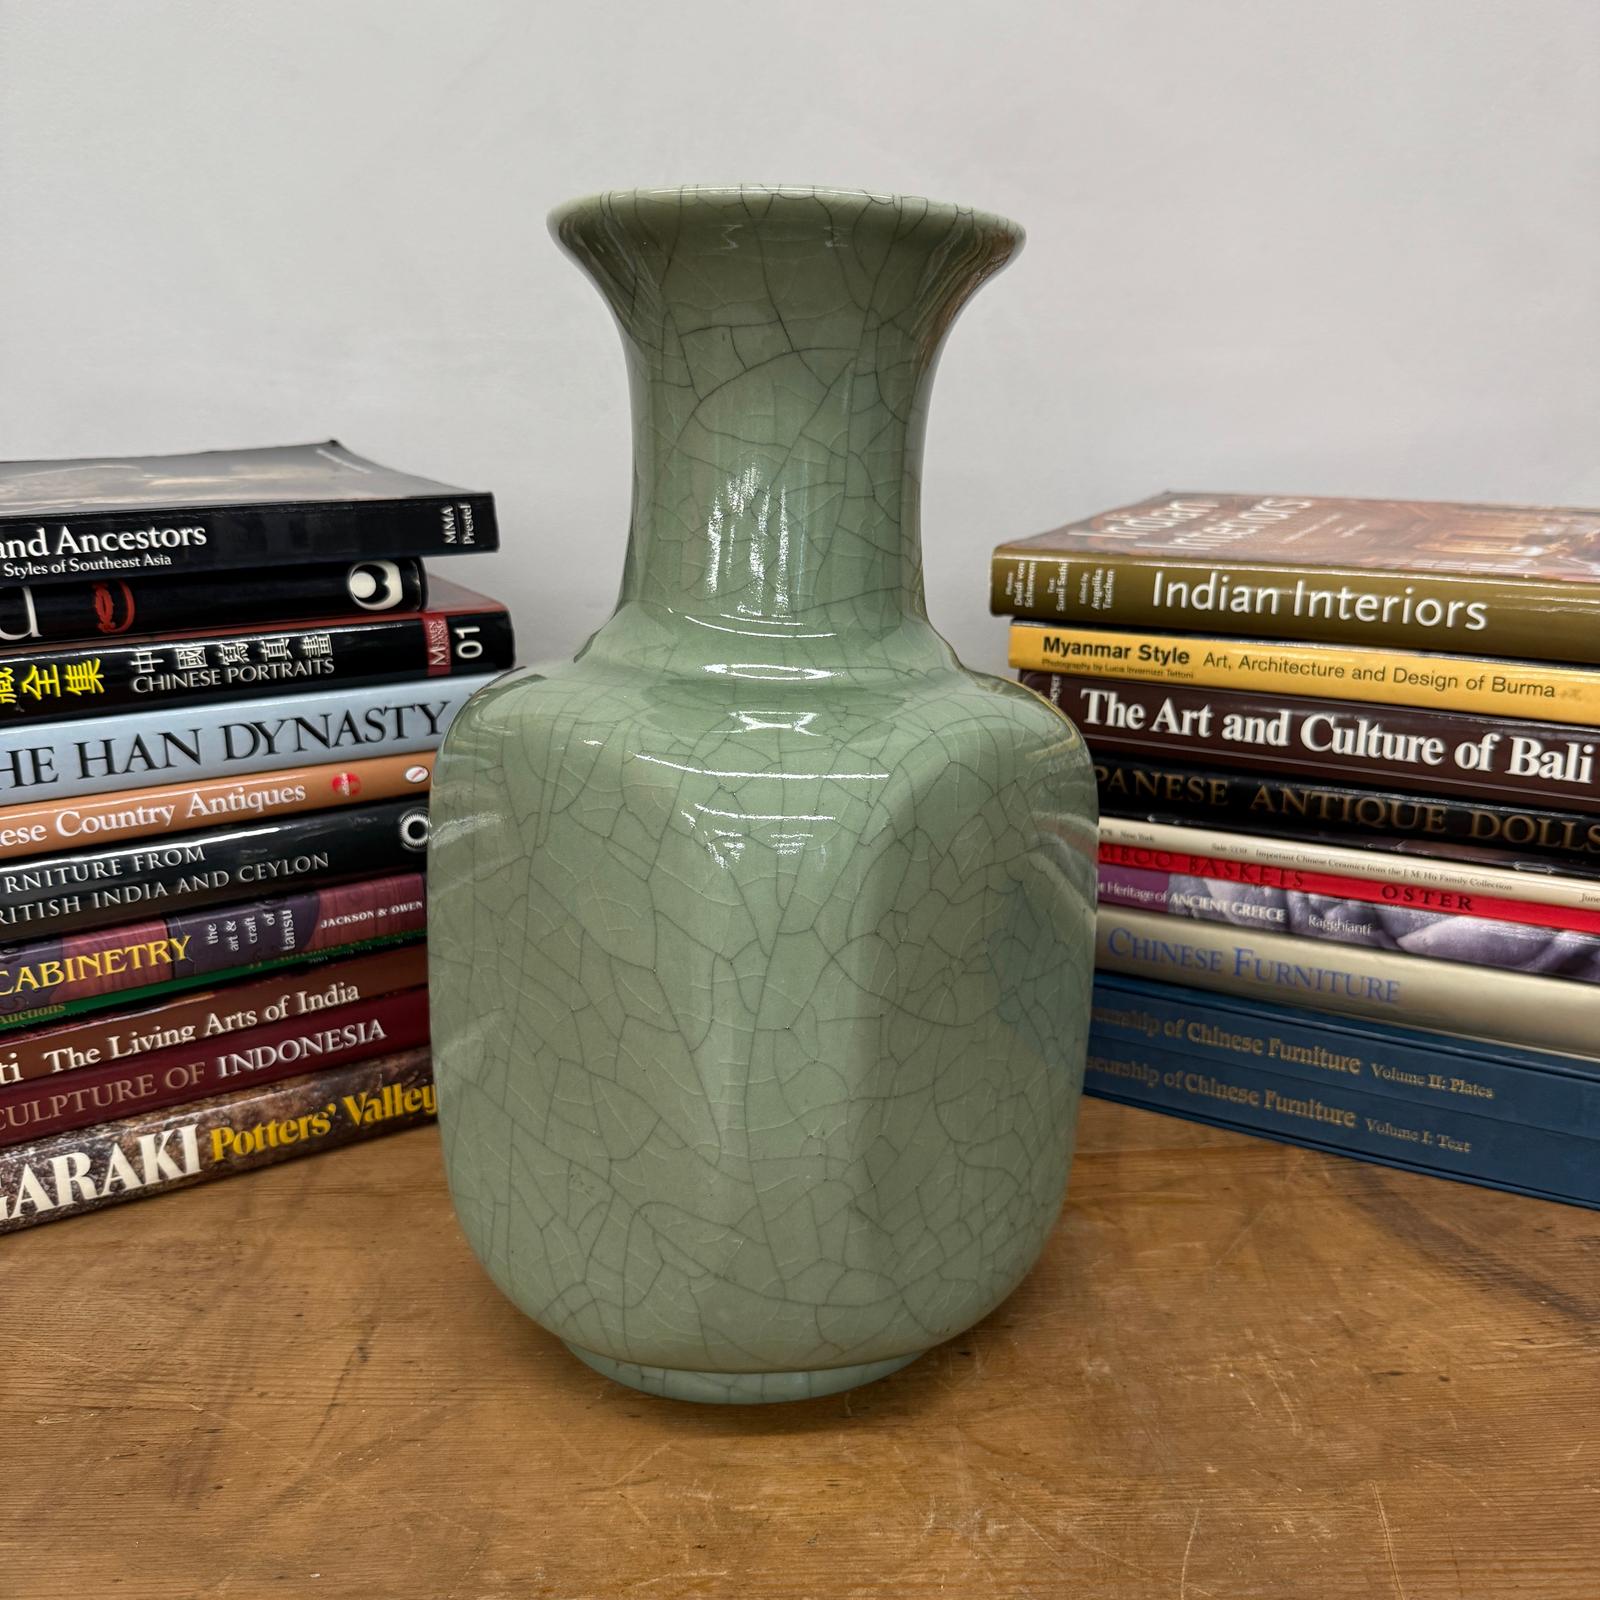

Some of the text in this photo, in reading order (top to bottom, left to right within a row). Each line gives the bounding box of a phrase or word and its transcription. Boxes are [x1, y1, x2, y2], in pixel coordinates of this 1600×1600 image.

[55, 525, 207, 555] Ancestors
[441, 505, 457, 544] MMA
[459, 503, 476, 544] Prestel
[4, 553, 172, 579] Styles of Southeast Asia
[1056, 588, 1065, 611] Sunil
[1091, 568, 1104, 610] Angelika
[1102, 569, 1115, 609] Taschen
[1152, 570, 1487, 631] Indian Interiors
[453, 626, 483, 659] 01
[132, 658, 334, 693] CHINESE PORTRAITS
[1042, 636, 1556, 698] Myanmar Style Art, Architecture and Design of Burma
[1093, 662, 1102, 672] by
[74, 728, 202, 779] HAN
[218, 701, 451, 761] DYNASTY
[1080, 687, 1595, 784] The Art and Culture of Bali
[0, 824, 47, 848] ese
[56, 804, 175, 837] Country
[185, 785, 306, 818] Antiques
[1250, 785, 1449, 834] ANTIQUE
[1469, 809, 1600, 853] DOLLS
[5, 846, 206, 893] RNITURE FROM
[93, 881, 169, 909] INDIA
[177, 870, 230, 894] AND
[236, 852, 330, 882] CEYLON
[1189, 855, 1303, 888] BASKETS
[1381, 884, 1473, 911] OSTER
[1296, 854, 1327, 865] Chinese
[1328, 857, 1366, 872] Ceramics
[1439, 873, 1468, 887] Family
[1469, 877, 1513, 891] Collection
[263, 913, 275, 926] of
[320, 900, 424, 928] JACKSON & OWEN
[1107, 881, 1154, 902] Heritage
[1155, 890, 1168, 903] of
[1169, 893, 1229, 913] ANCIENT
[1231, 902, 1287, 923] GREECE
[207, 923, 219, 944] the
[225, 920, 239, 952] art &
[244, 916, 258, 944] craft
[281, 909, 296, 950] tansu
[1108, 927, 1401, 1001] CHINESE FURNITURE
[43, 1047, 101, 1073] The
[108, 1026, 196, 1059] Living
[204, 1010, 258, 1037] Arts
[265, 995, 290, 1022] of
[297, 981, 360, 1014] India
[165, 1062, 206, 1090] OF
[217, 1018, 387, 1078] INDONESIA
[1164, 1018, 1185, 1039] of
[1187, 1022, 1264, 1056] Chinese
[1268, 1037, 1362, 1075] Furniture
[1371, 1063, 1425, 1086] Volume
[1428, 1074, 1446, 1090] II:
[1449, 1077, 1495, 1099] Plates
[1164, 1070, 1185, 1089] of
[1185, 1073, 1261, 1107] Chinese
[1264, 1087, 1358, 1128] Furniture
[1365, 1118, 1419, 1142] Volume
[1437, 1133, 1472, 1153] Text
[0, 1124, 202, 1220] ARAKI
[342, 1083, 436, 1127] Valley
